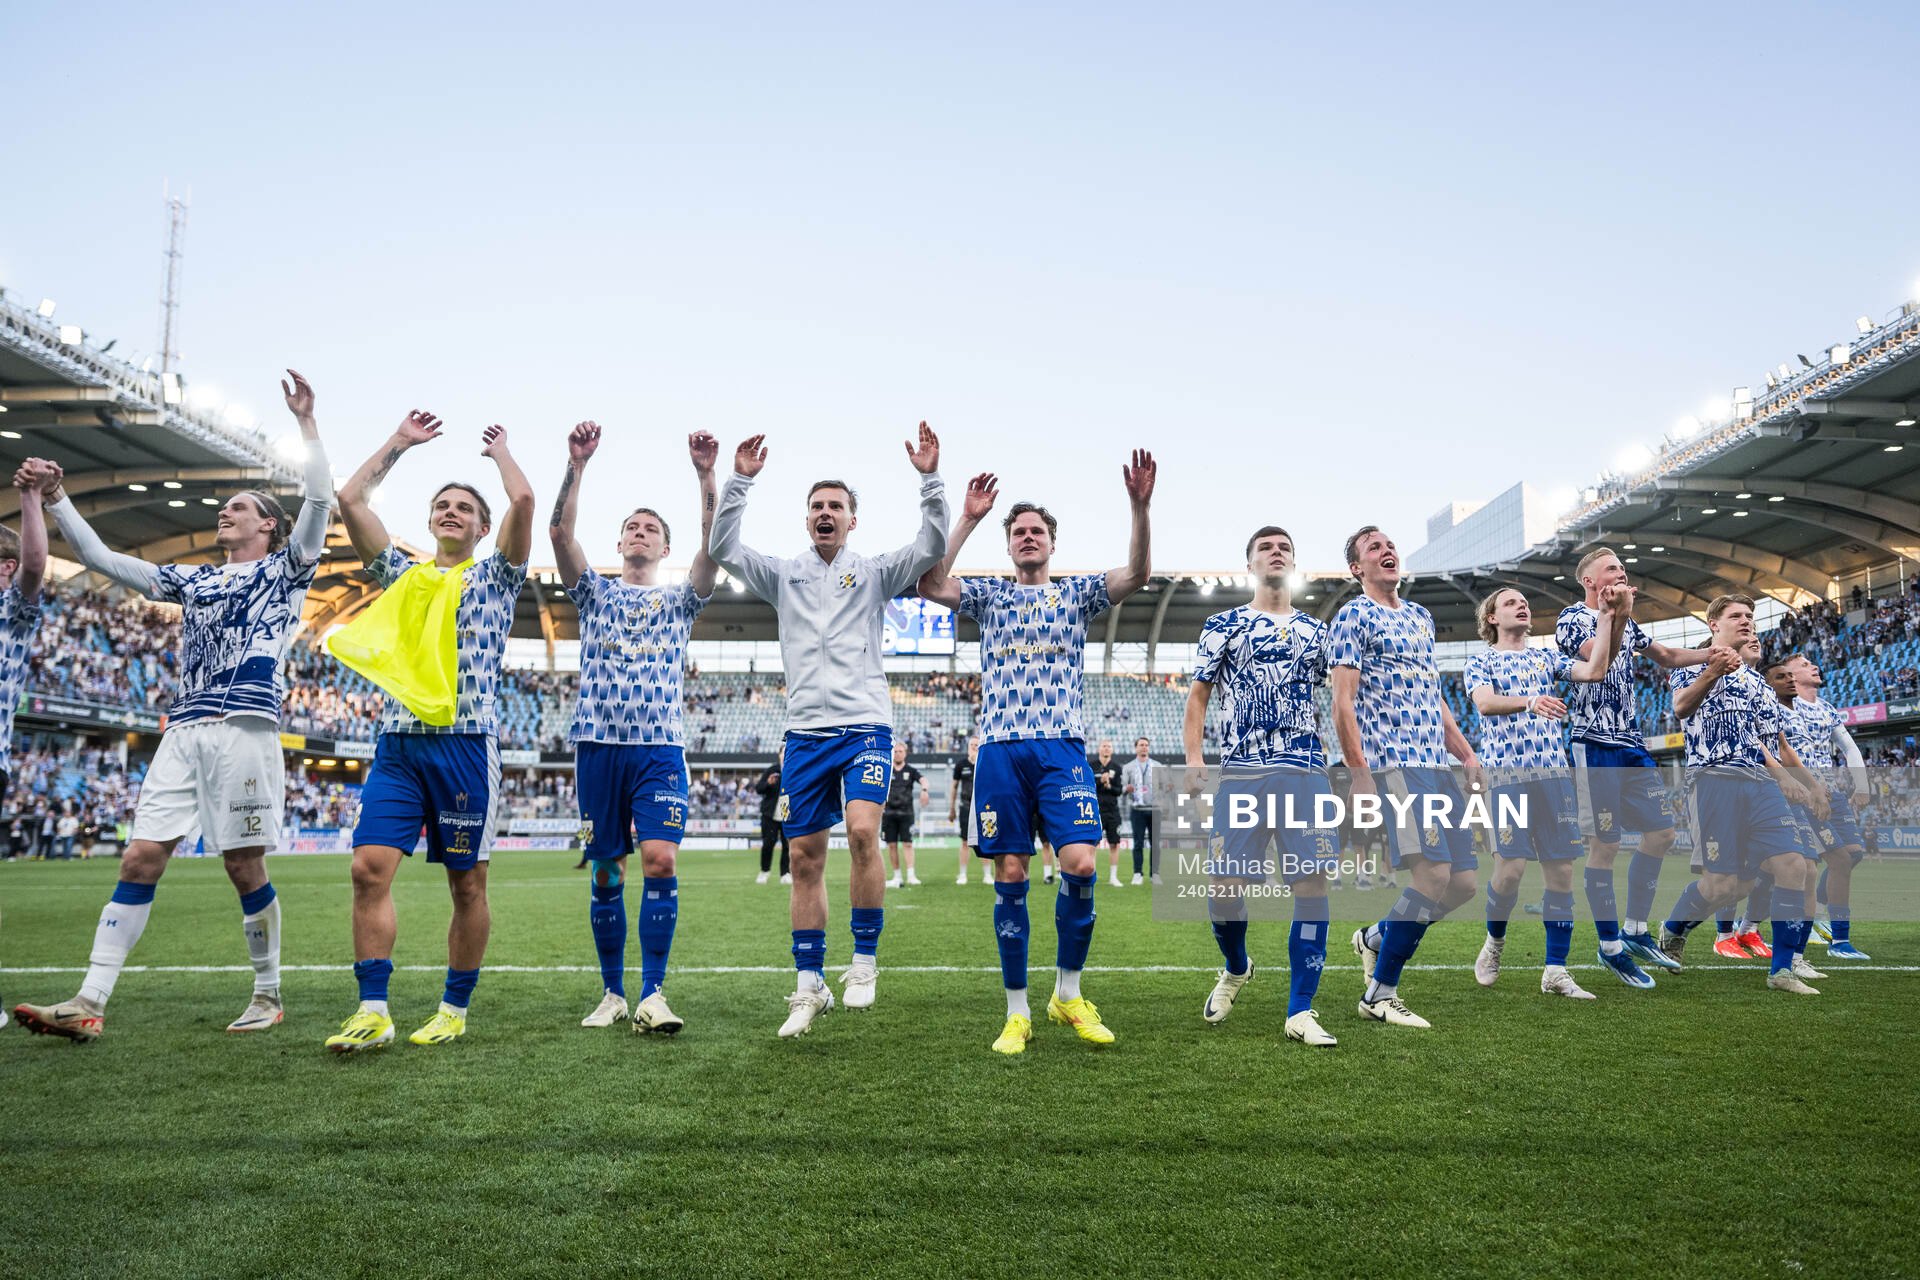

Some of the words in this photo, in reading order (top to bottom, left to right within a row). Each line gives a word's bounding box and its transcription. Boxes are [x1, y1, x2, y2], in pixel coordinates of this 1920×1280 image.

[863, 763, 884, 782] 28
[861, 778, 882, 786] CRAFT
[668, 806, 682, 823] 15
[1076, 801, 1095, 819] 14
[244, 815, 262, 832] 12
[663, 820, 681, 828] CRAFT
[453, 831, 470, 849] 16
[497, 838, 564, 848] INTERSPORT
[1315, 837, 1334, 854] 36
